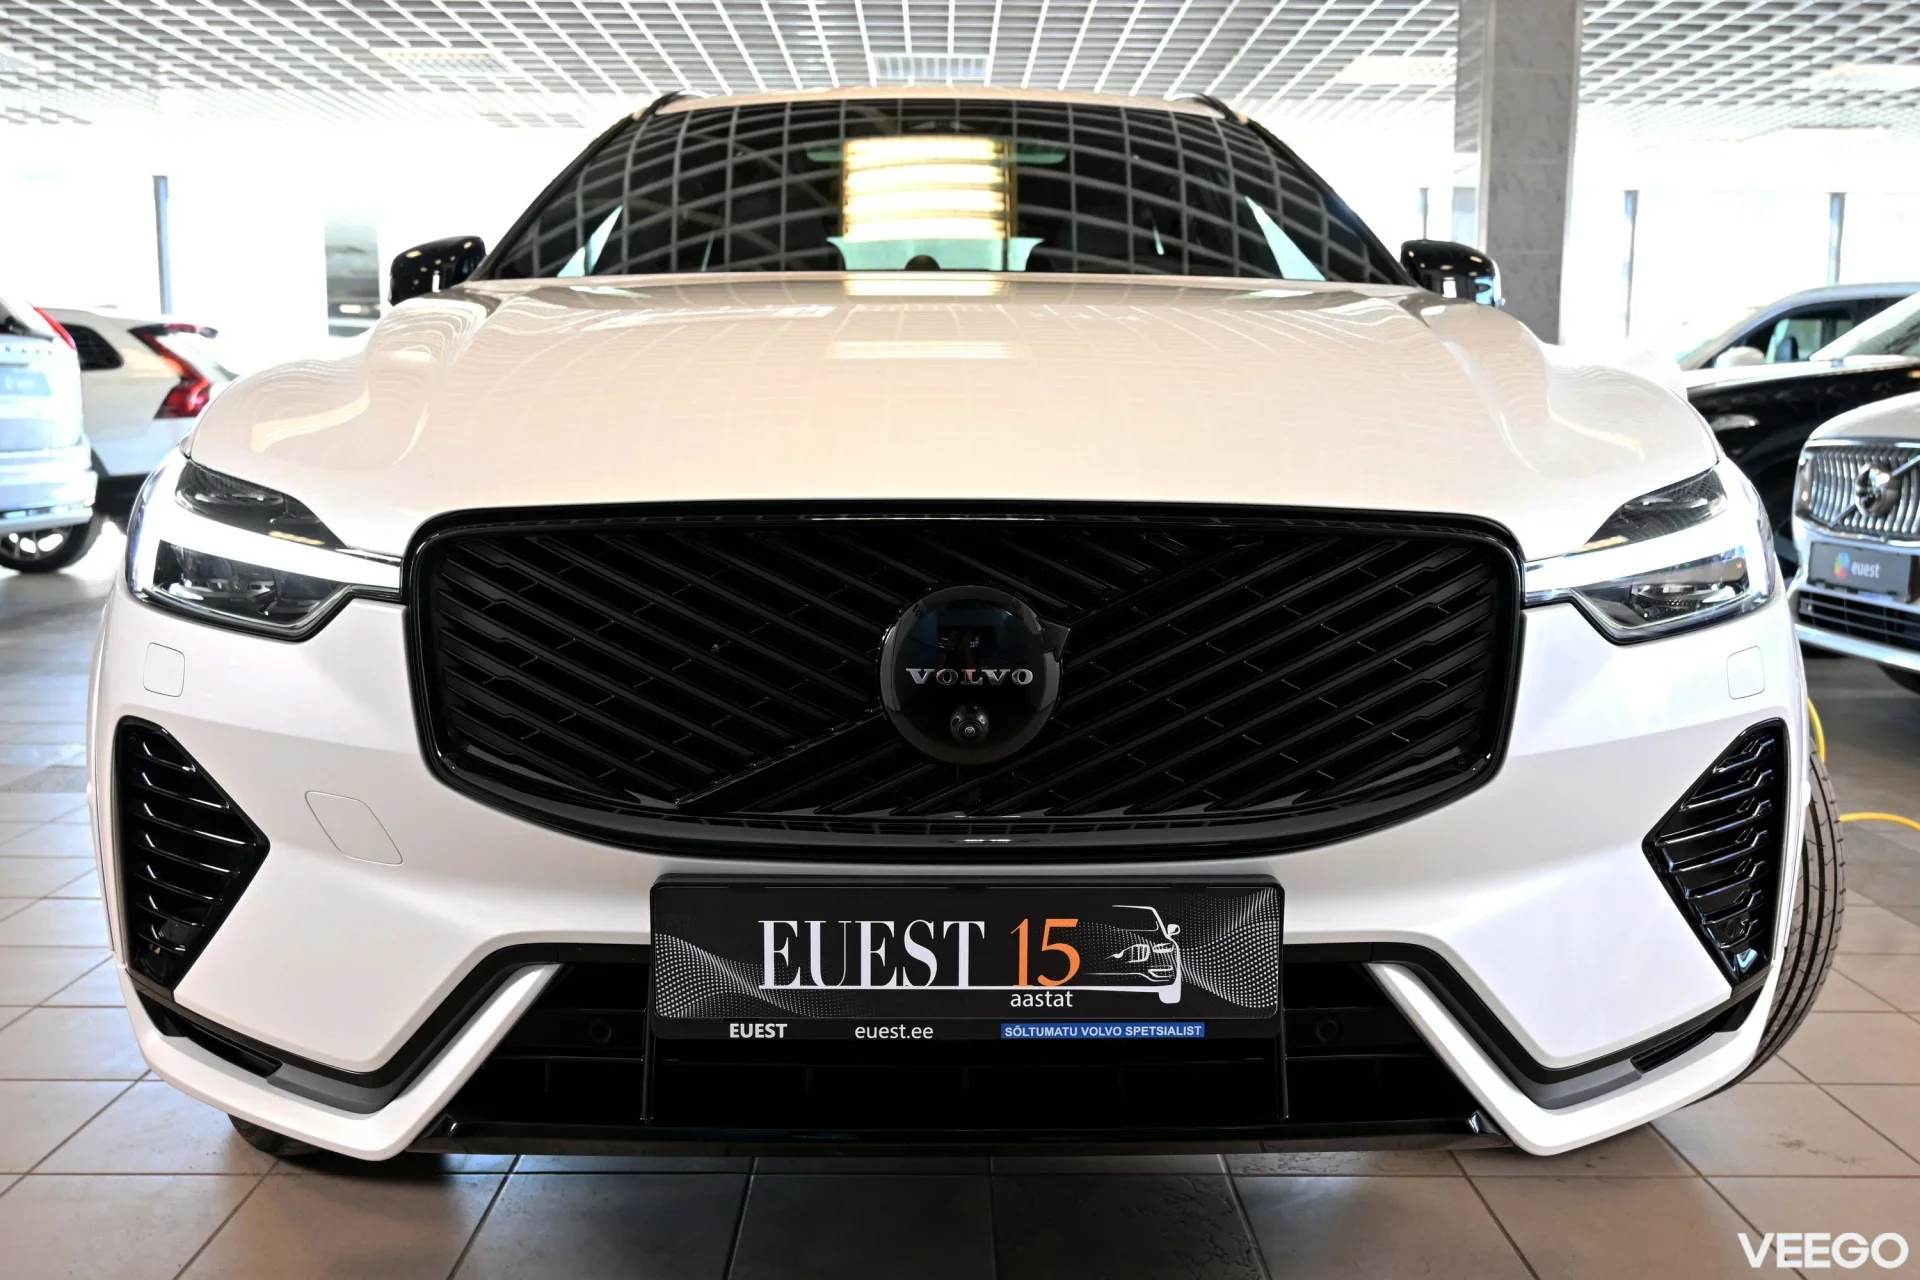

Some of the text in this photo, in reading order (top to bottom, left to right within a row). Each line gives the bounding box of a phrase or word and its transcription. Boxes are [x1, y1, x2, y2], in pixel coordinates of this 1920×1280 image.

[1851, 561, 1881, 579] euest
[905, 668, 1034, 685] VOLVO
[757, 918, 1081, 987] EUEST 15
[1010, 991, 1074, 1008] aastat
[729, 1023, 788, 1039] EUEST
[854, 1023, 934, 1039] euest.ee
[1004, 1024, 1202, 1037] SÕLTUMATU VOLVO SPETSIALIST
